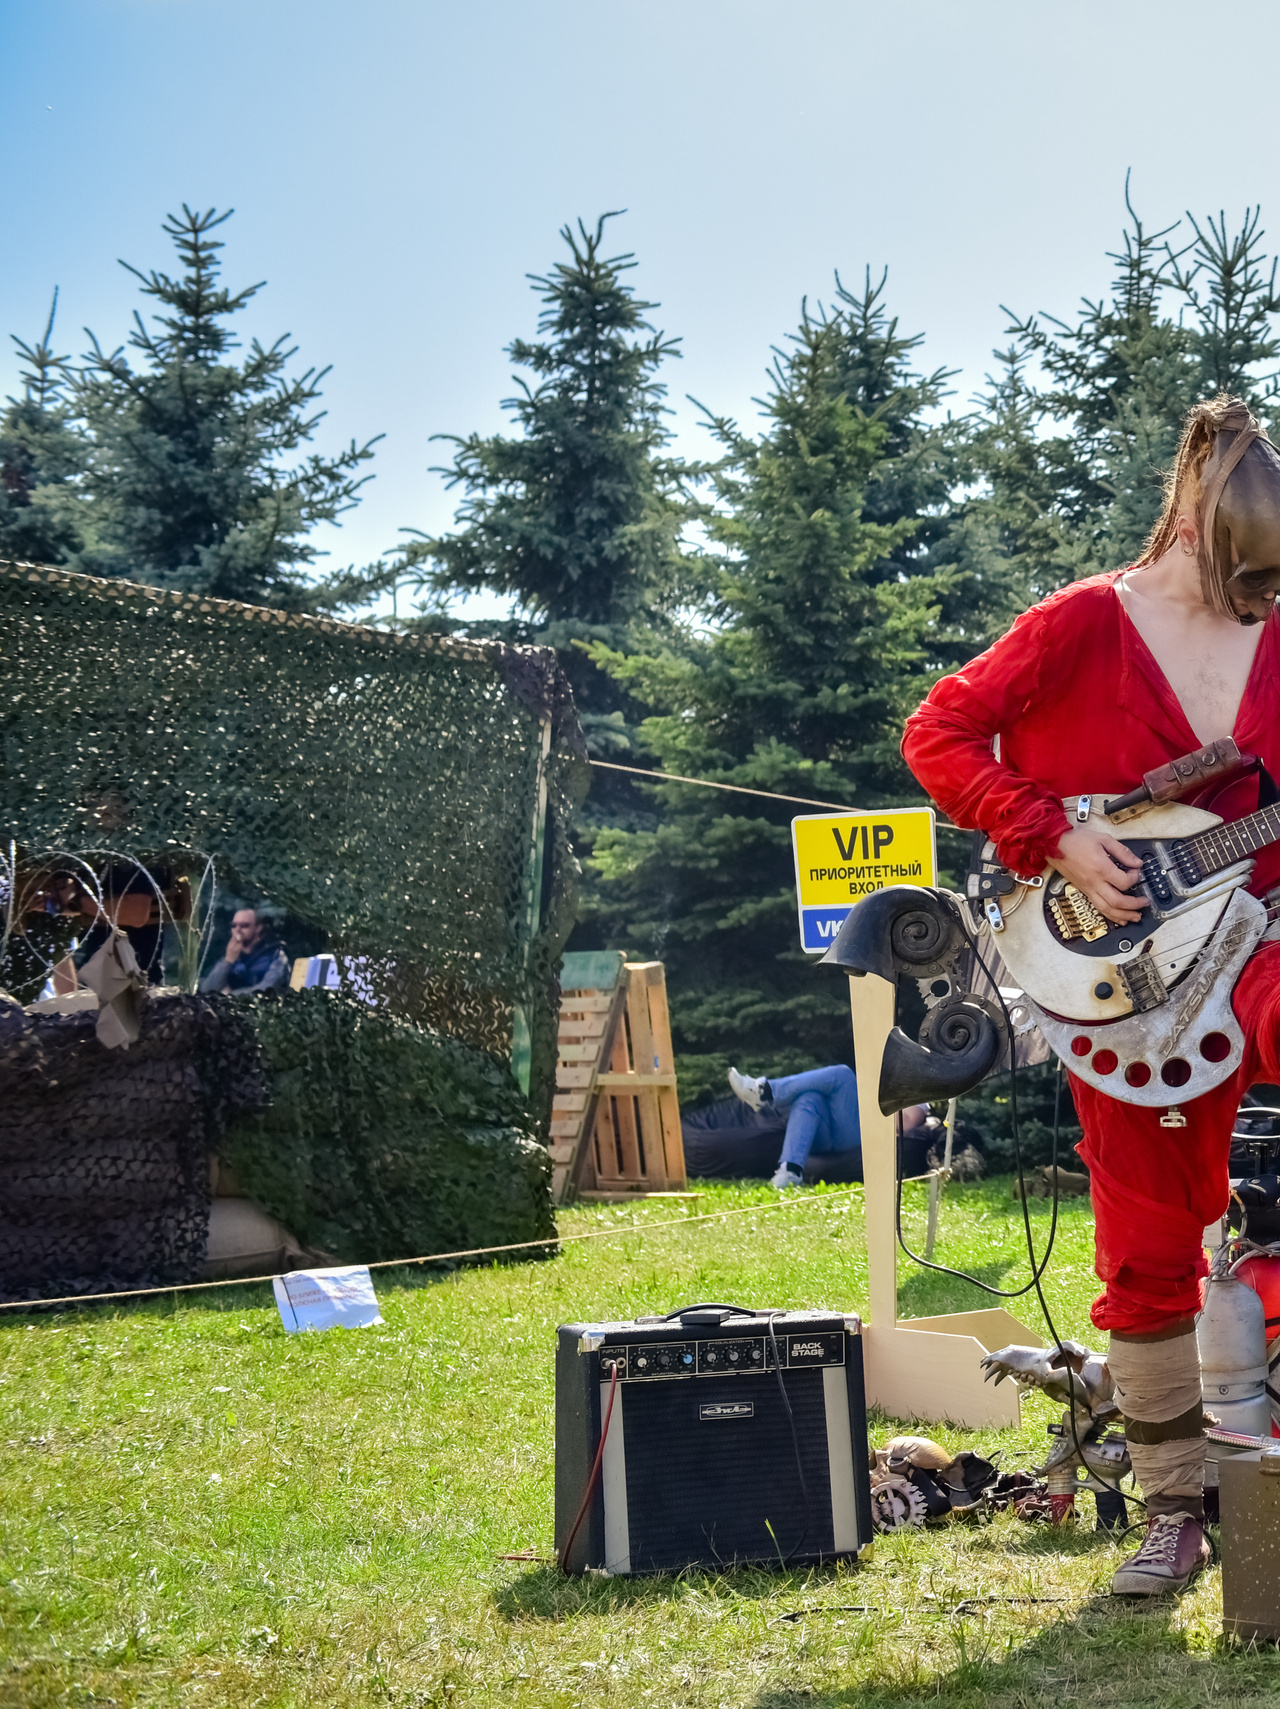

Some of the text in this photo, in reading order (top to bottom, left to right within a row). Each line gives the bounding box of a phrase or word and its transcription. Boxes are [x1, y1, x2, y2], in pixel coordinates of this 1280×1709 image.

[832, 824, 894, 861] VIP
[809, 860, 922, 882] ПРИОРИТЕТНЫЙ
[791, 1349, 825, 1357] STAGE
